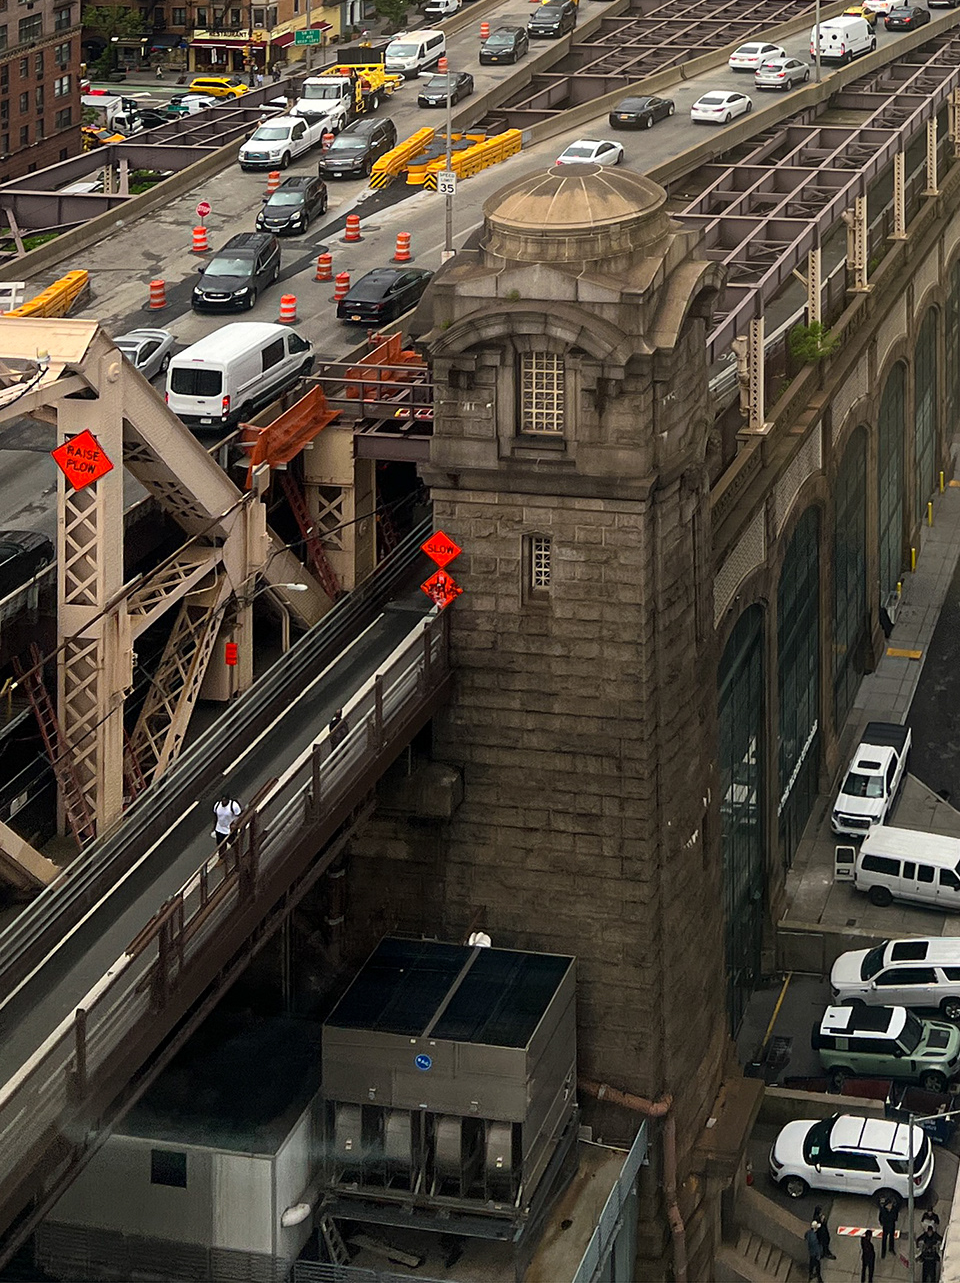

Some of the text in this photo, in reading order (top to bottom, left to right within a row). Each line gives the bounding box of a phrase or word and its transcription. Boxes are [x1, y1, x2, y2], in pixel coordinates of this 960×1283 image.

[440, 183, 454, 193] 35
[197, 205, 211, 213] STOP
[66, 444, 100, 462] RAISE
[66, 458, 96, 474] PLOW
[427, 543, 454, 555] SLOW
